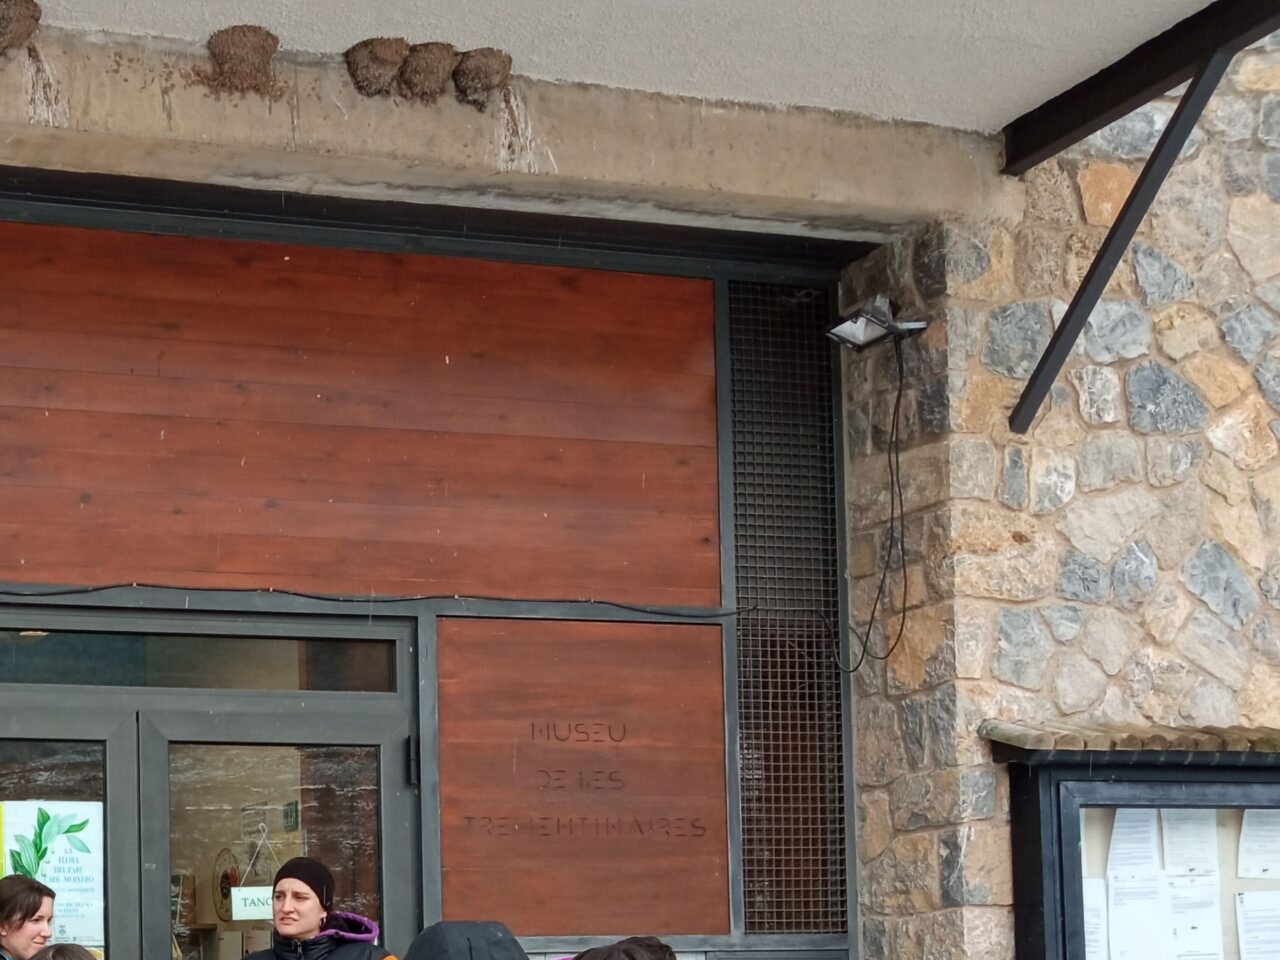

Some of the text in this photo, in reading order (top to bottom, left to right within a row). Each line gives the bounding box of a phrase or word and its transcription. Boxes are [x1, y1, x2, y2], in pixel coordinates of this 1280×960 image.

[531, 722, 626, 742] MUSEU
[537, 769, 624, 790] DE LES
